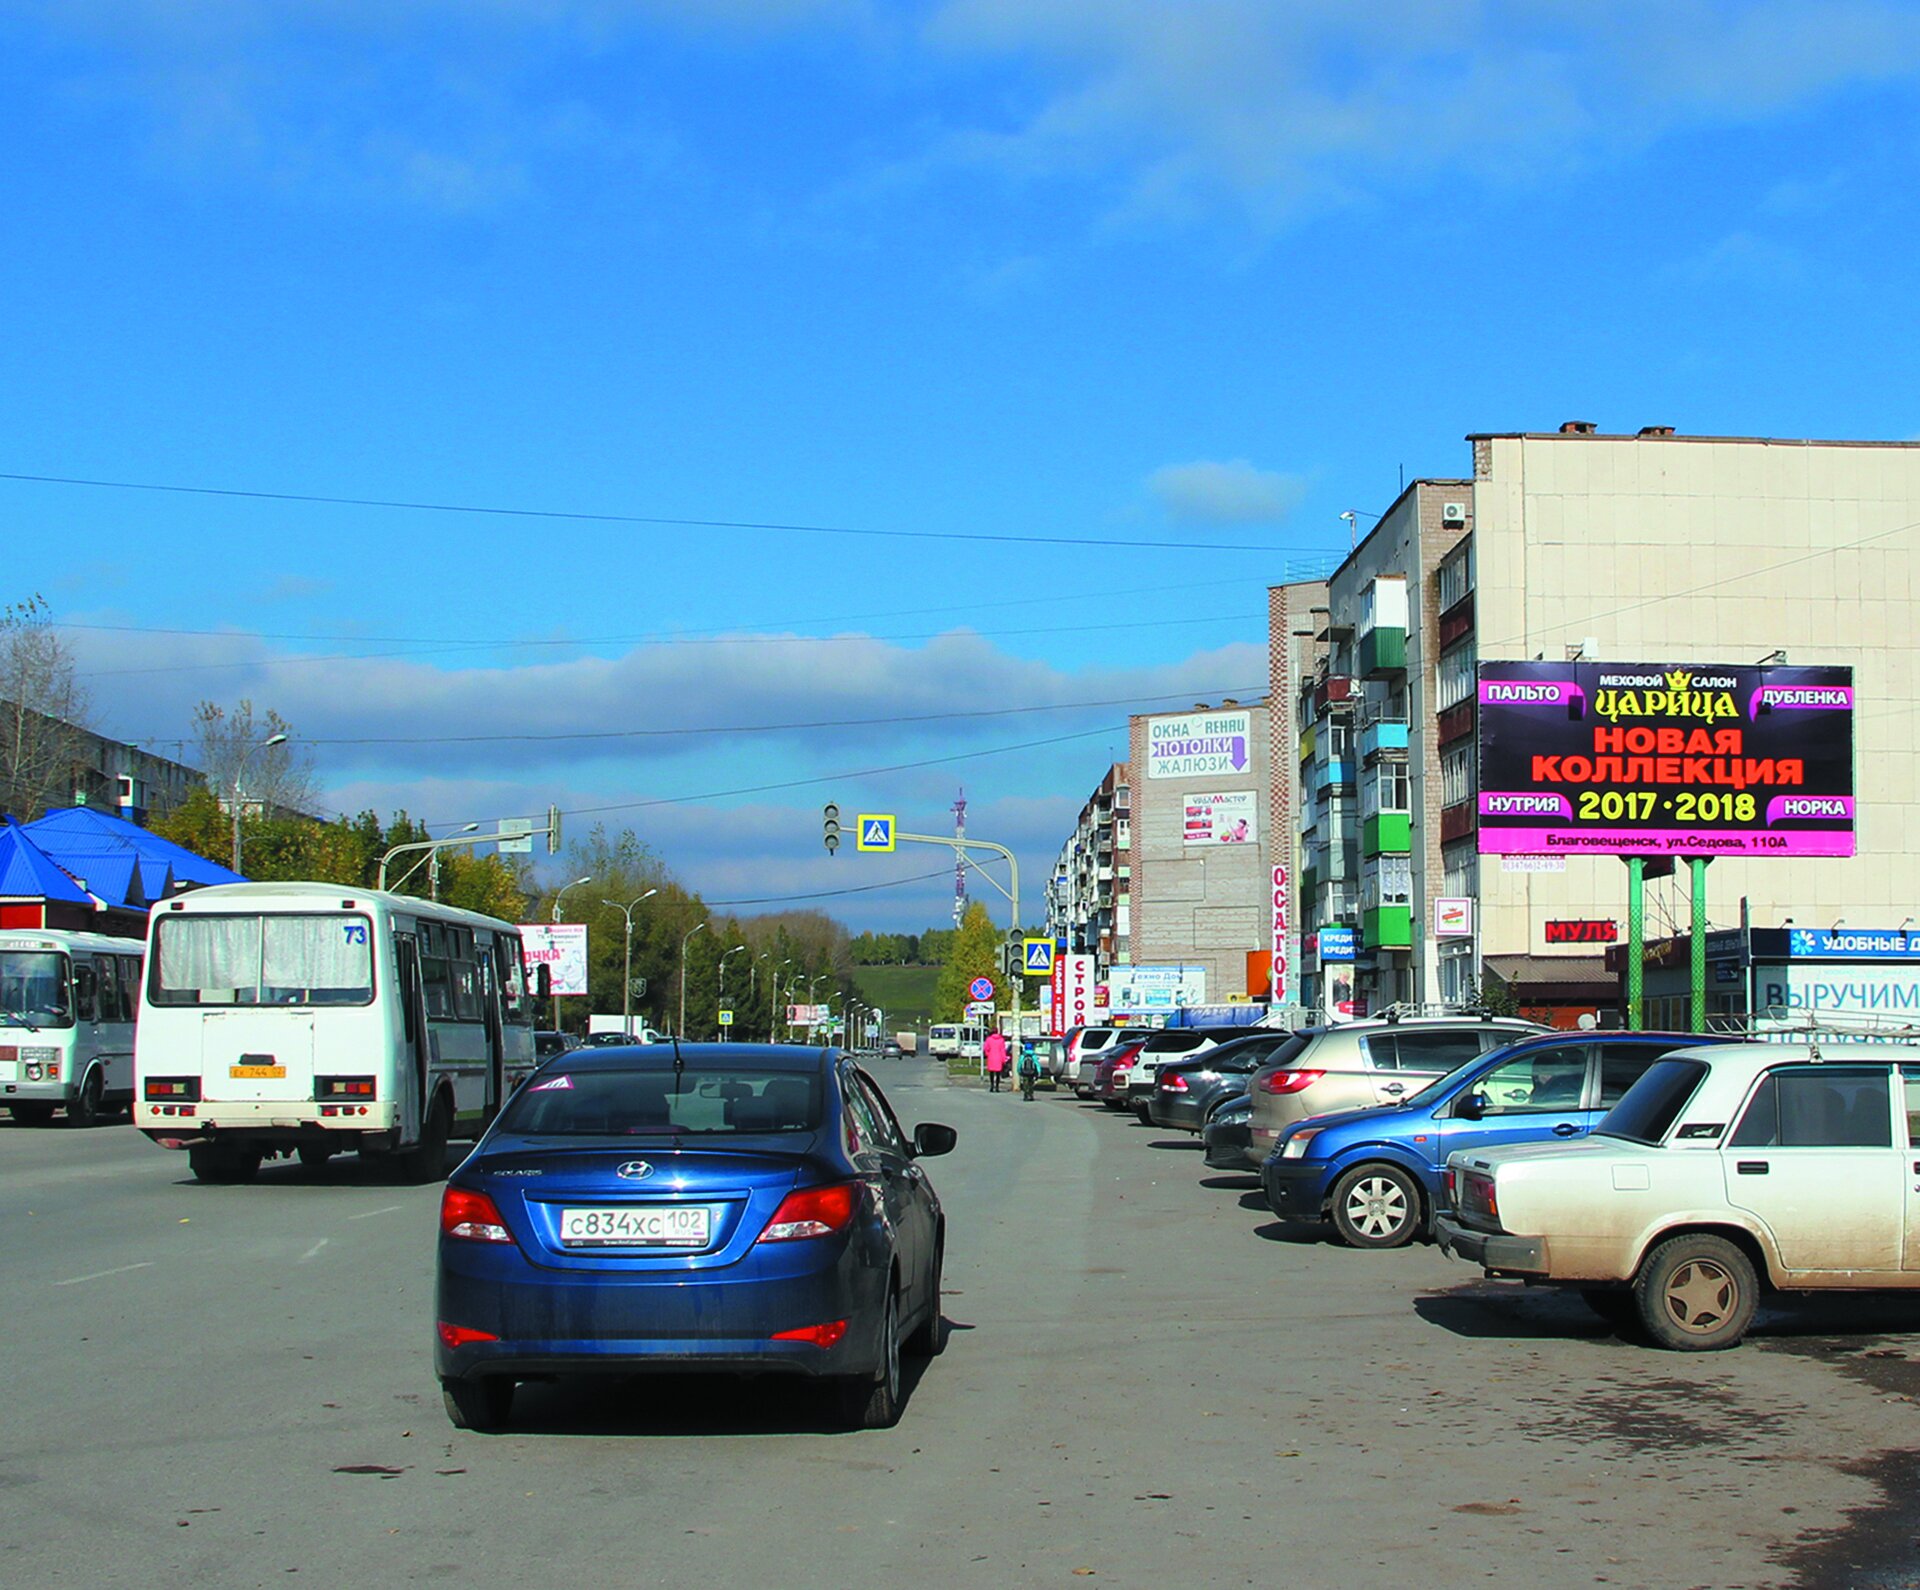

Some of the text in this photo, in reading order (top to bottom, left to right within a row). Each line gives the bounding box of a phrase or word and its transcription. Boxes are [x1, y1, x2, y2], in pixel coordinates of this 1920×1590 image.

[1600, 674, 1737, 688] МЕХОВОЙ САЛОН
[1487, 685, 1560, 701] ПАЛЬТО
[1762, 690, 1848, 706] ДУБЛЕНКА
[1594, 689, 1740, 724] ЦАРИЦА
[1153, 723, 1190, 738] ОКНА
[1158, 737, 1233, 756] ПОТОЛКИ
[1594, 727, 1742, 755] НОВАЯ
[1158, 756, 1228, 774] ЖАЛЮЗИ
[1531, 755, 1804, 790] КОЛЛЕКЦИЯ
[1488, 797, 1560, 812] НУТРИЯ
[1578, 791, 1756, 821] 2017 2018
[1784, 800, 1846, 815] НОРКА
[1547, 834, 1661, 848] Благовещенск,
[1752, 837, 1788, 848] 110А
[1273, 867, 1287, 975] ОСАГО
[343, 926, 367, 944] 73
[1822, 936, 1906, 951] УДОБНЫЕ
[1074, 961, 1085, 1026] СТРОЙ
[1766, 983, 1920, 1010] ВЫРУЧИМ
[570, 1211, 701, 1235] С834ХС 102
